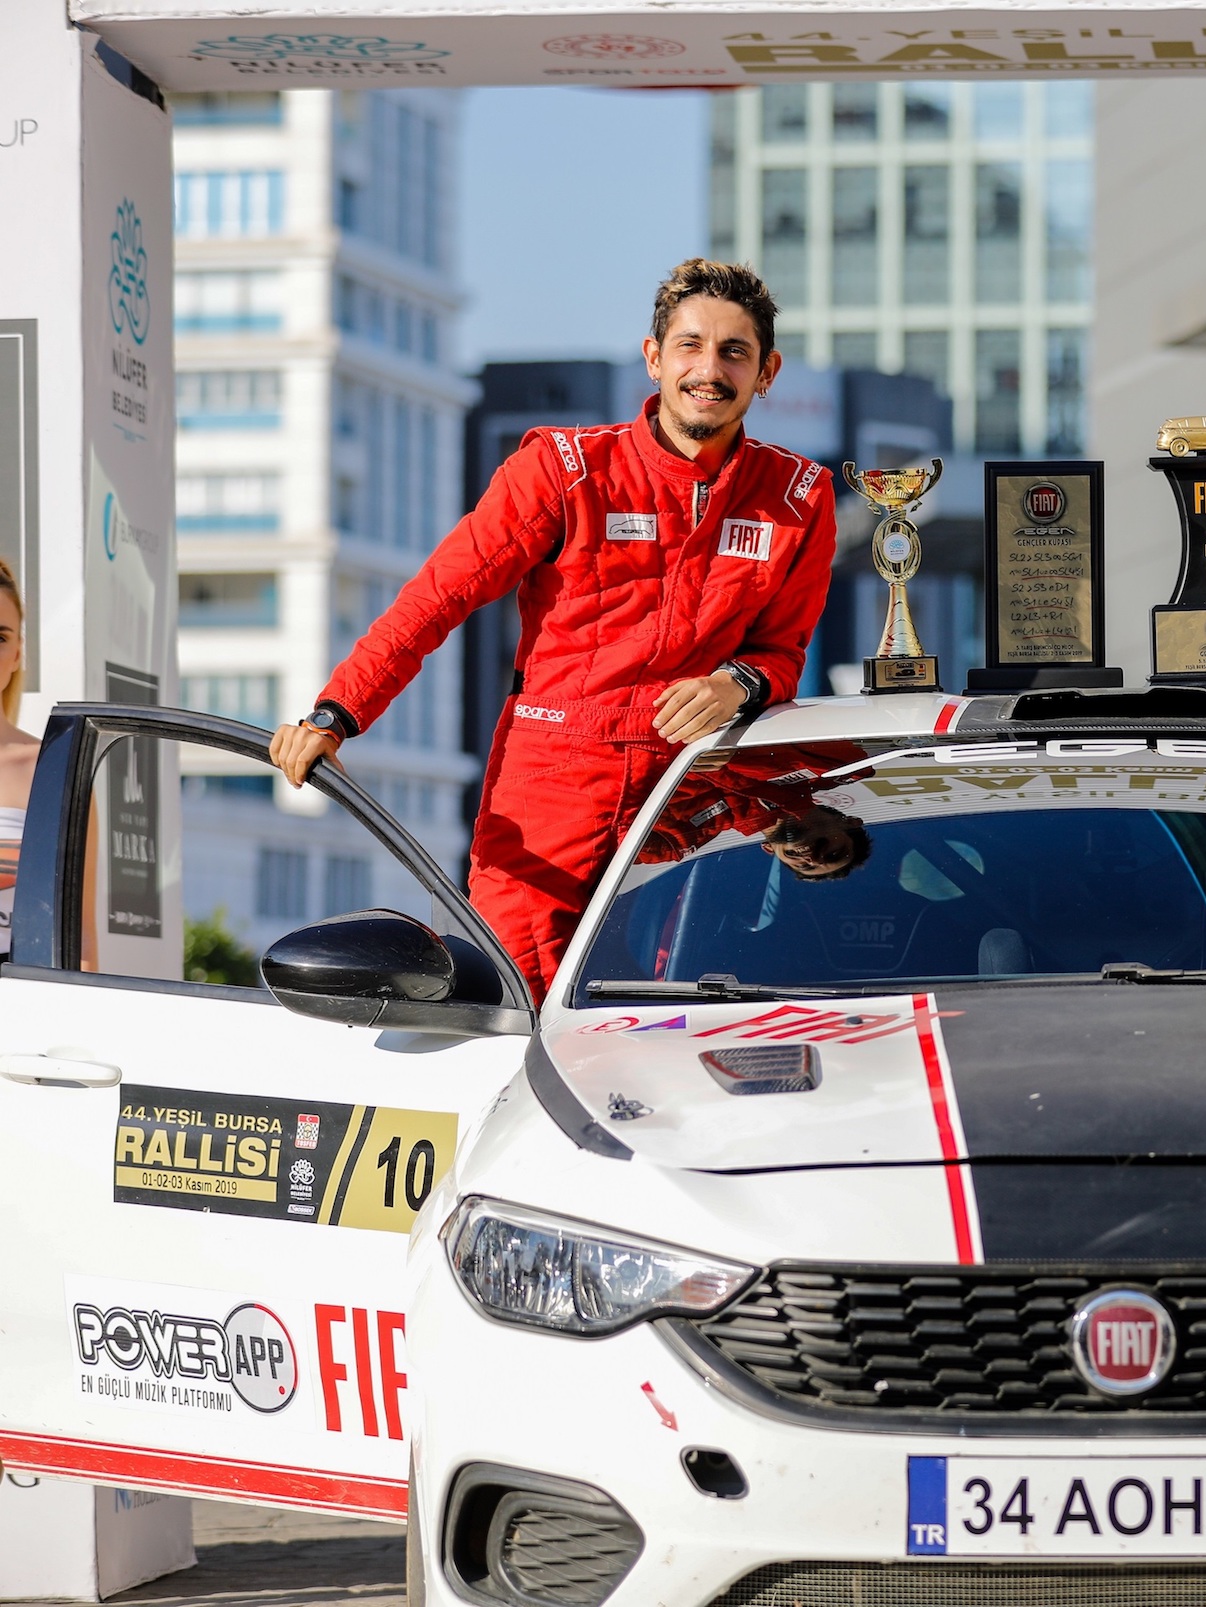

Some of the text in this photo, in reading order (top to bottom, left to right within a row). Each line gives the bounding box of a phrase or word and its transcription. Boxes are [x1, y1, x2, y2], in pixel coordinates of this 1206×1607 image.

[550, 431, 579, 473] sparco
[793, 461, 822, 500] sparco
[1033, 493, 1056, 512] FIAT
[727, 524, 765, 556] FIAT
[513, 703, 565, 722] sparco
[840, 921, 895, 941] OMP
[689, 1004, 966, 1044] FIAT
[214, 1111, 283, 1135] BURSA
[142, 1172, 238, 1196] 01-02-03 Kasım 2019
[376, 1136, 437, 1213] 10
[73, 1302, 285, 1383] POWER APP
[1097, 1320, 1155, 1367] FIAT
[81, 1374, 232, 1412] EN GÜÇLÜ MÜZİK PLATFORMU
[962, 1477, 1035, 1536] 34
[1054, 1477, 1202, 1536] AOH
[911, 1523, 945, 1546] TR
